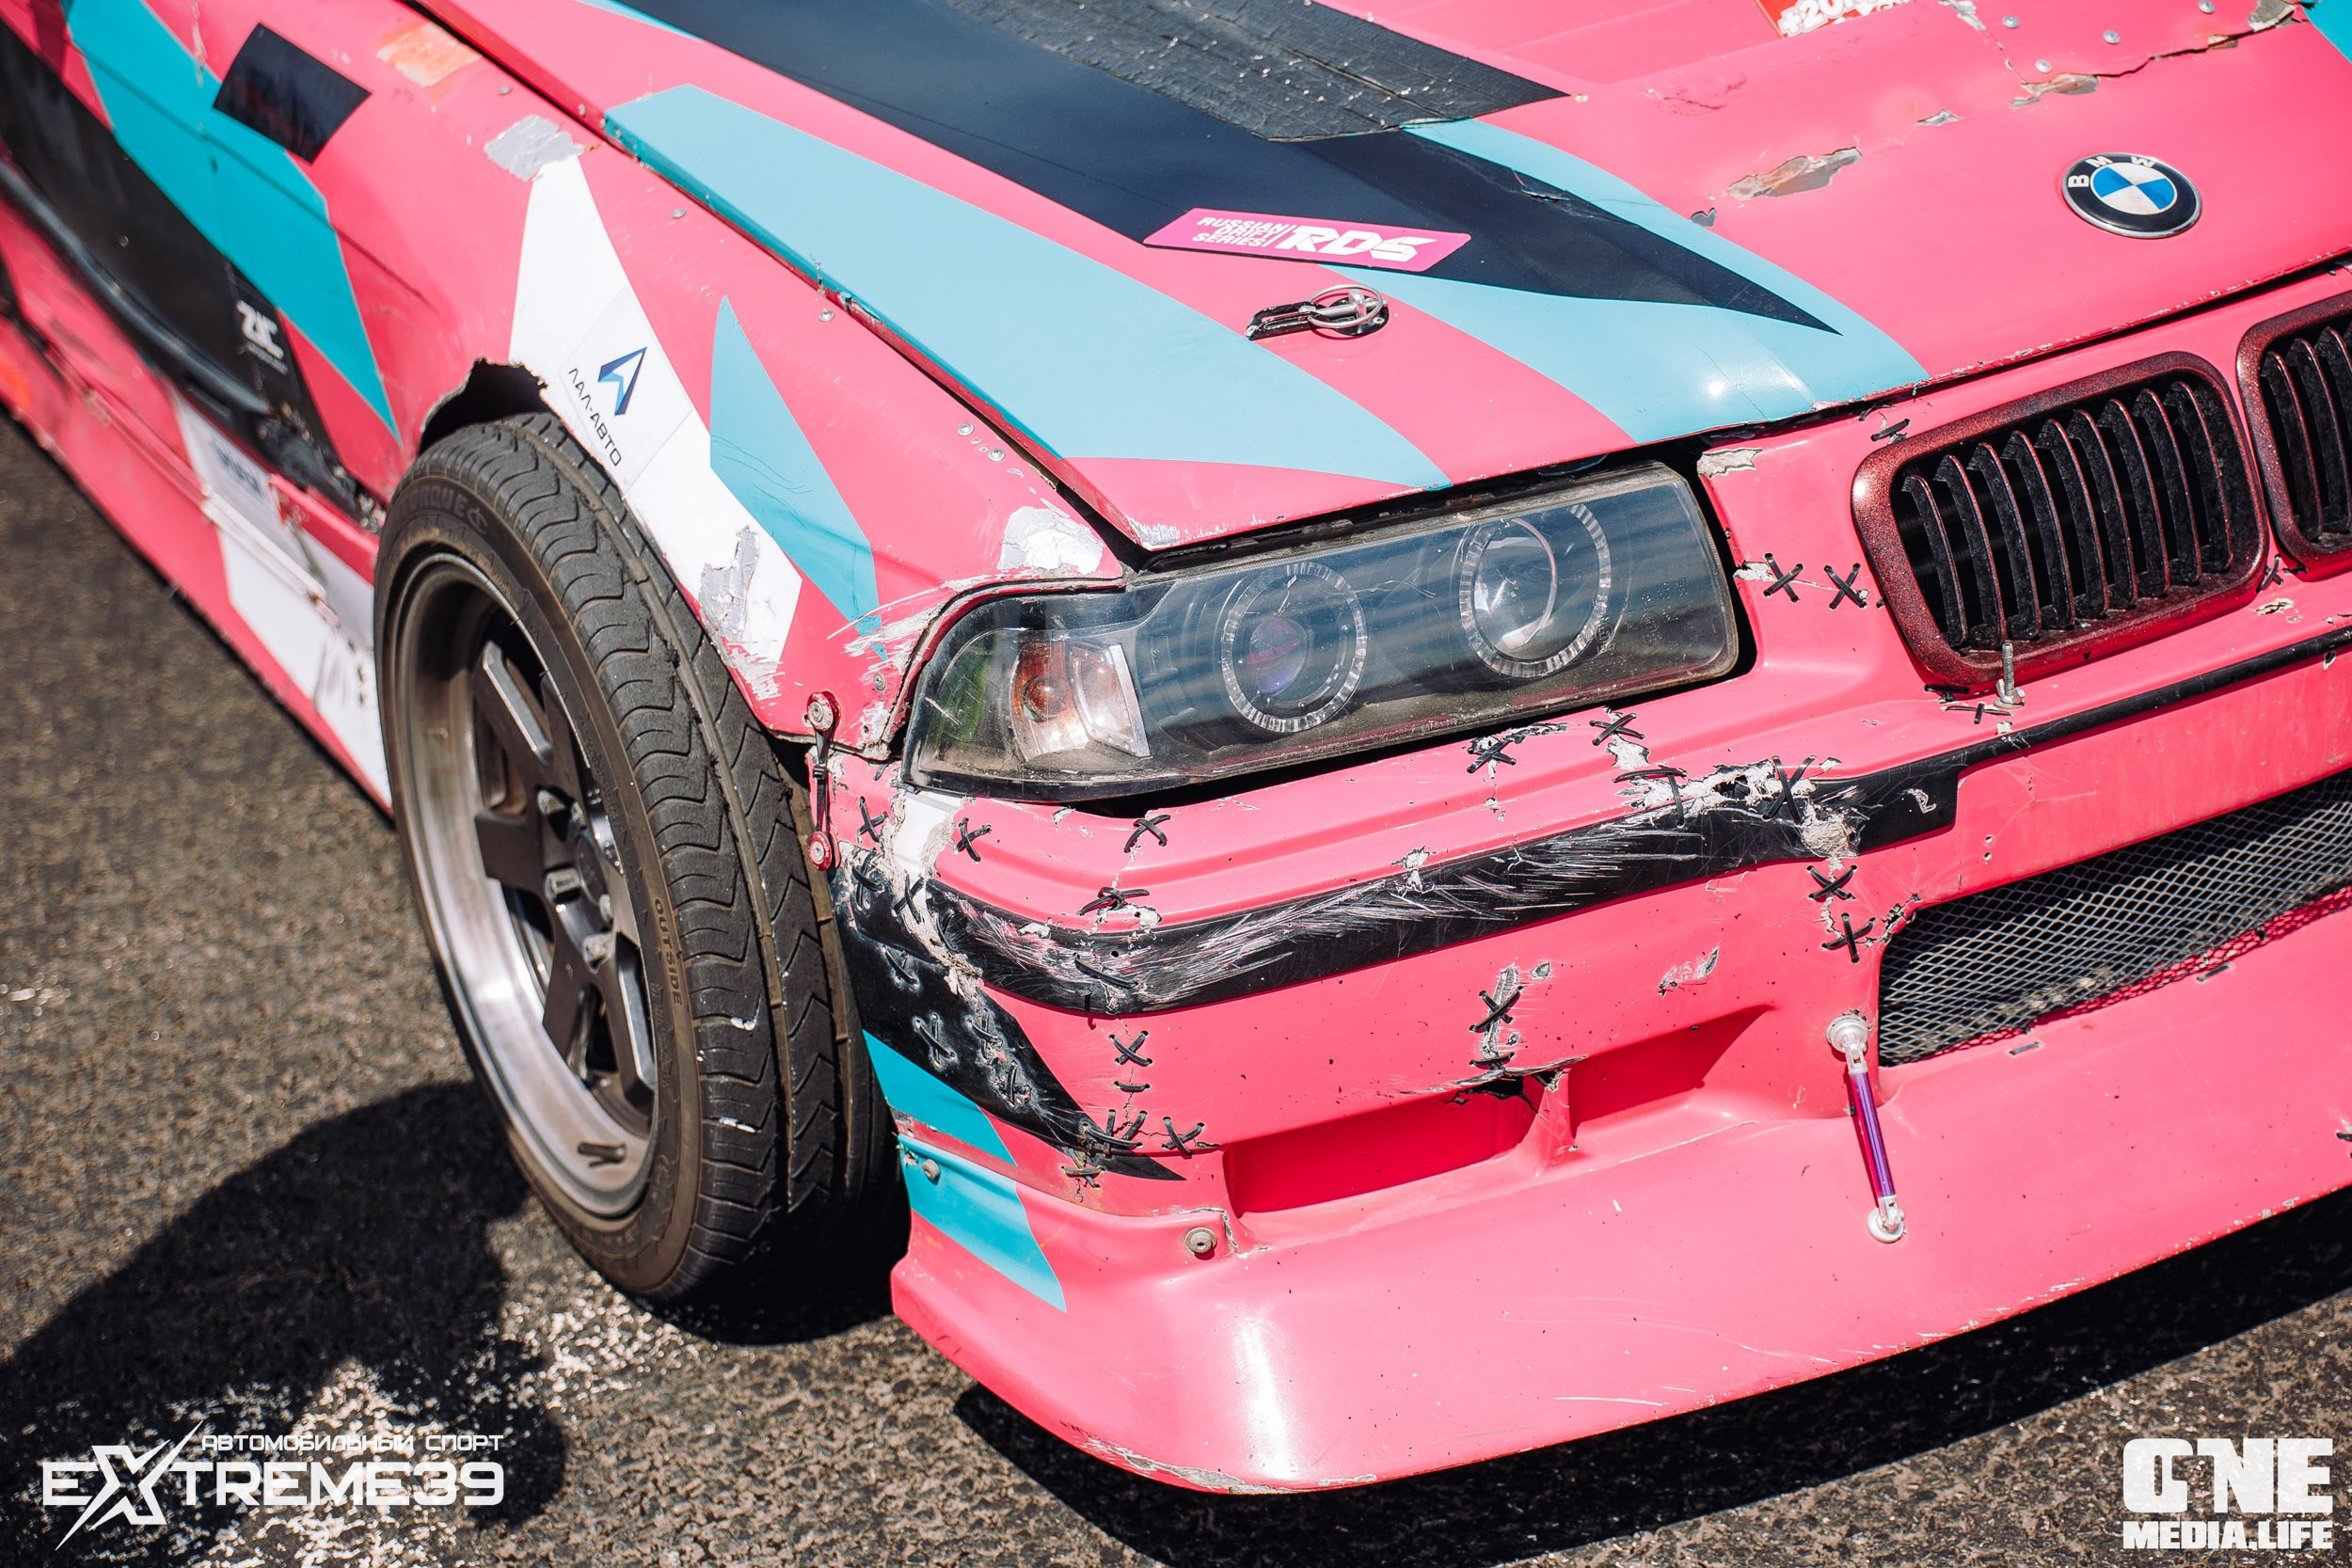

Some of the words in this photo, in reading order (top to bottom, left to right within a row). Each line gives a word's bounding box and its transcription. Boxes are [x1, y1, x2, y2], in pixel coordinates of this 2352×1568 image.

[2068, 156, 2156, 188] BMW
[1192, 232, 1266, 247] SERIES
[1197, 217, 1290, 234] RUSSIAN
[1214, 225, 1280, 239] DRIFT
[1275, 225, 1438, 262] RDS
[568, 368, 622, 467] ЛАЛ-АВТО
[655, 896, 683, 1006] OUTSIDE
